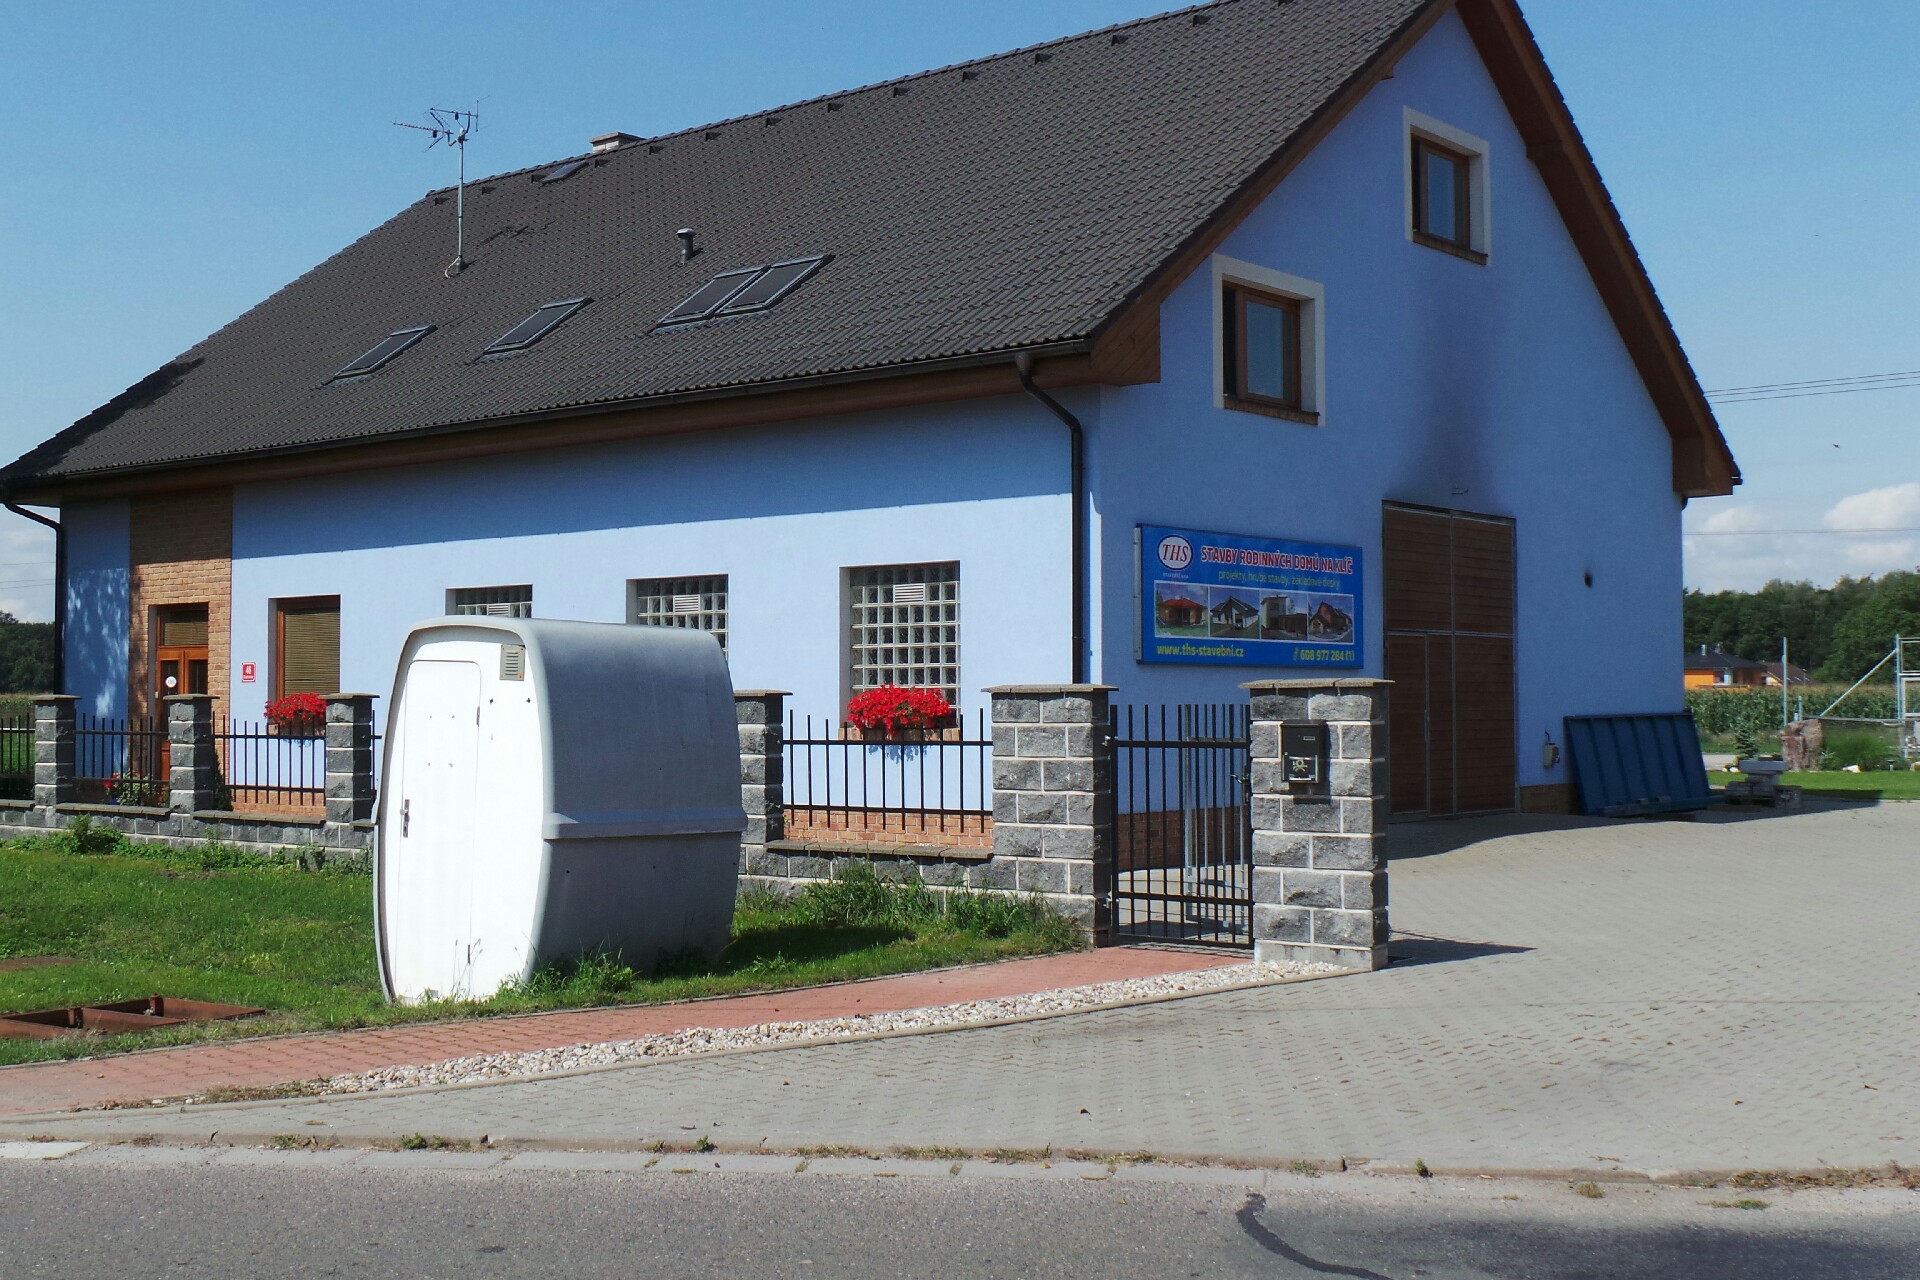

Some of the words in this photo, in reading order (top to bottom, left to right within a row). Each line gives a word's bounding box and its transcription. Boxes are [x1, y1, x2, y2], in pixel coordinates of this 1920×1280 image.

[1162, 544, 1189, 562] THS
[1201, 545, 1239, 564] STAVBY
[1240, 549, 1292, 569] RODINNÝCH
[1294, 552, 1320, 572] DOMŮ
[1321, 557, 1333, 573] NA
[1335, 556, 1353, 575] KLÍČ
[1157, 643, 1244, 658] www.ths-stavebni.cz
[1300, 649, 1315, 661] 608
[1316, 649, 1329, 661] 977
[1331, 650, 1344, 661] 284
